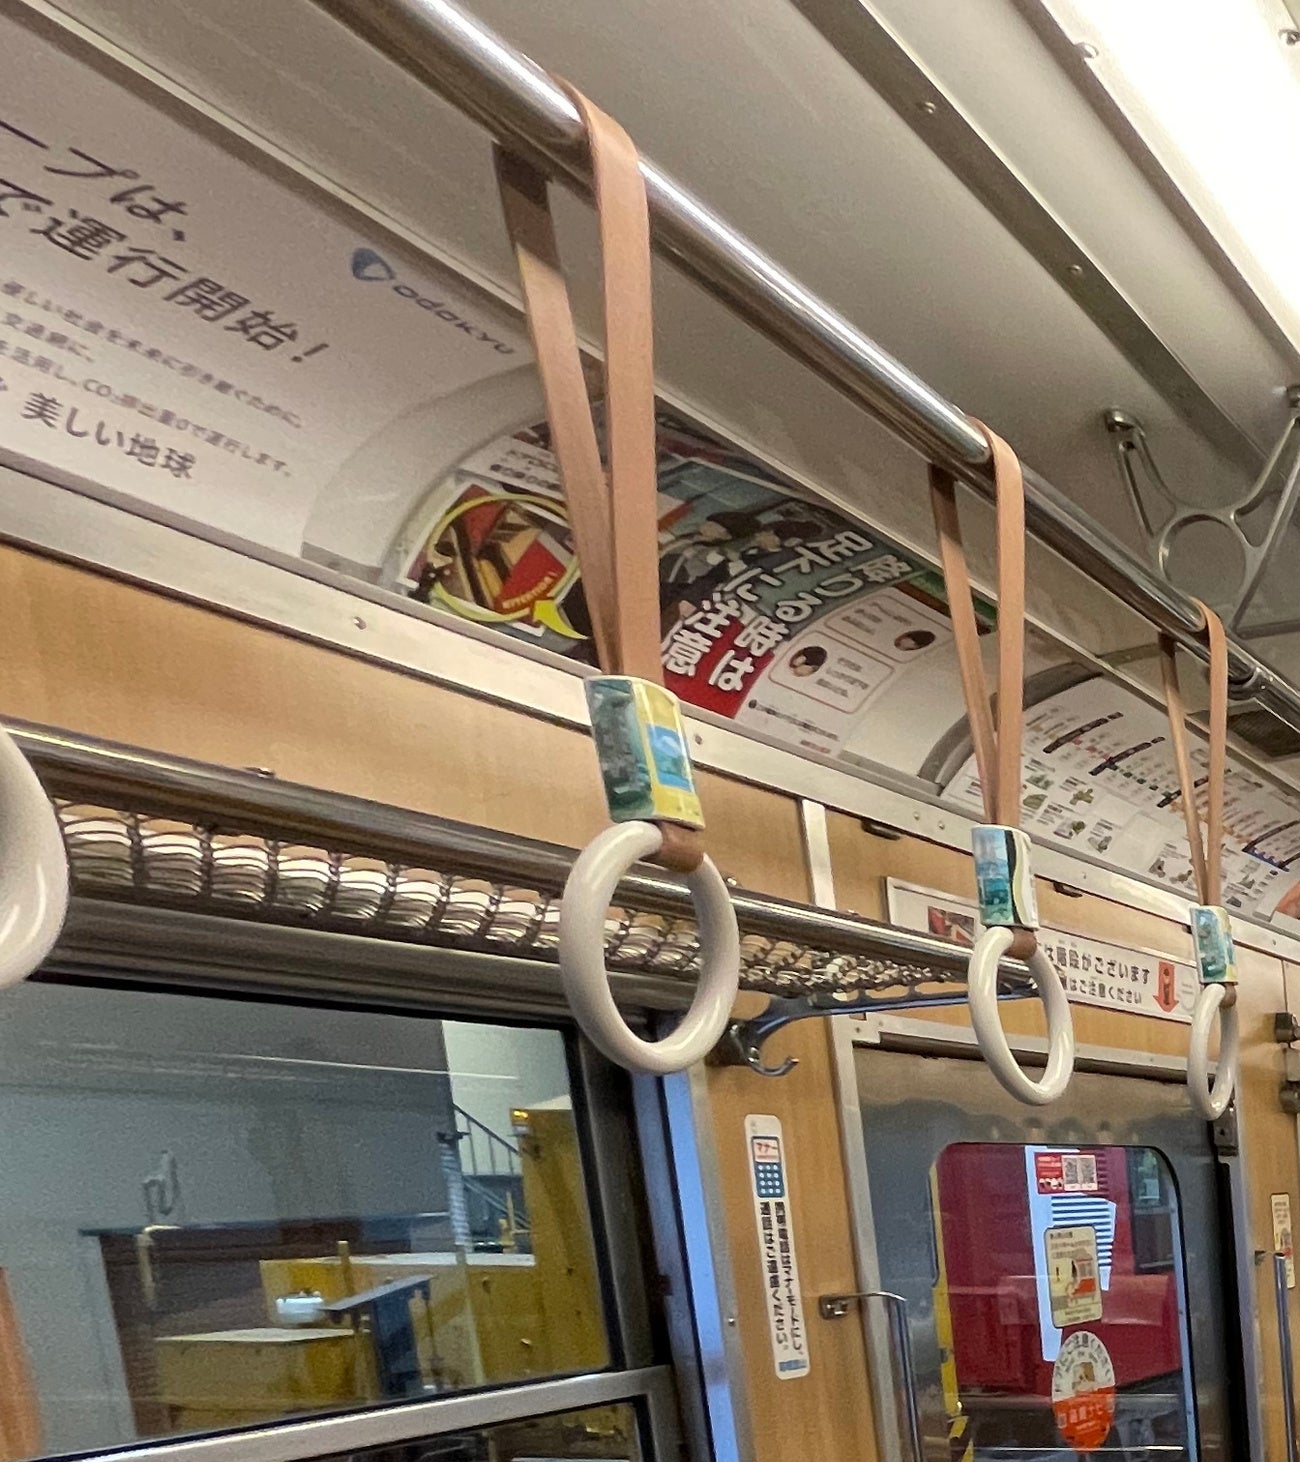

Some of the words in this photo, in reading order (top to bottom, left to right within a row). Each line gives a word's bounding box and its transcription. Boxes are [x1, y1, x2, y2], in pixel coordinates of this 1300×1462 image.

[20, 391, 198, 480] 美しい地球
[708, 553, 914, 692] 降りる時は
